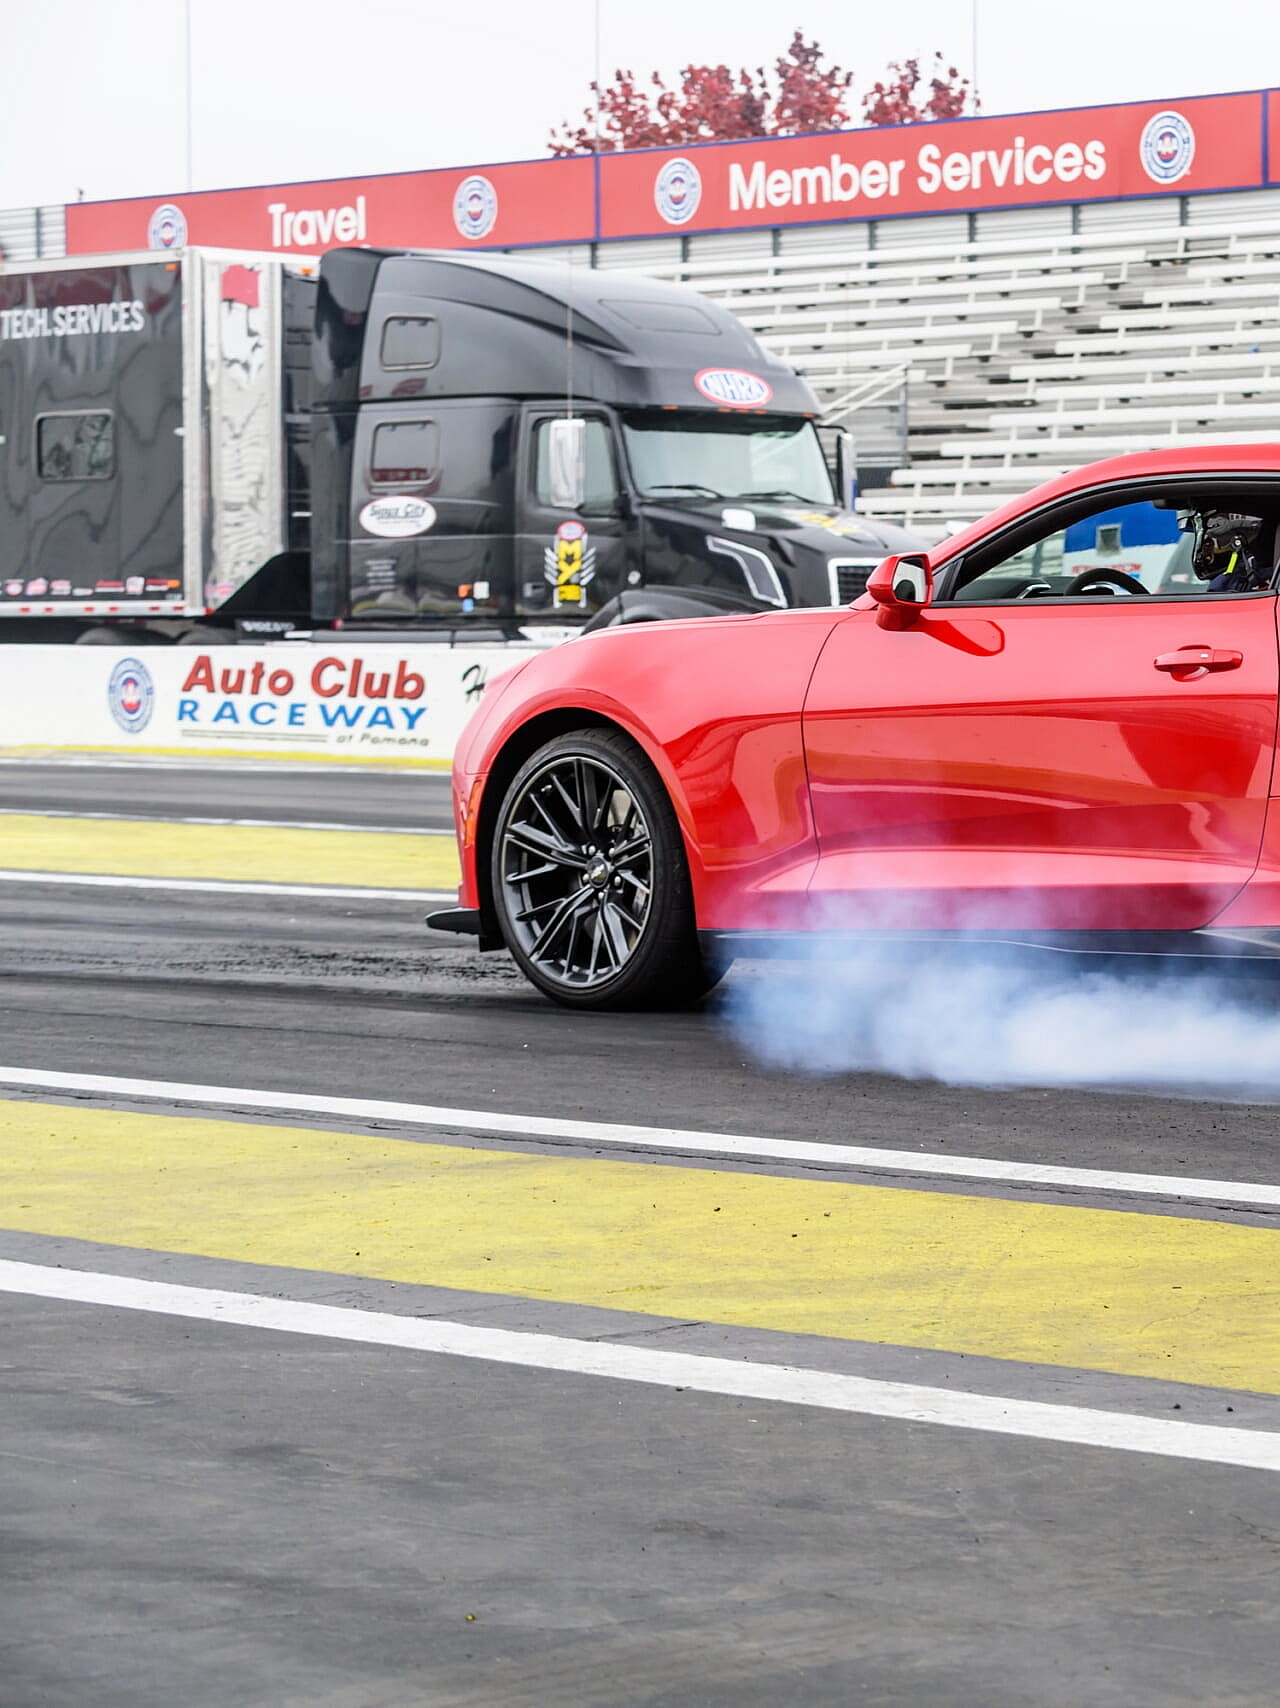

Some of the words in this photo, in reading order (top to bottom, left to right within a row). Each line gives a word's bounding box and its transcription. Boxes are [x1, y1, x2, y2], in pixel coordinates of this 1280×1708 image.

[728, 153, 906, 211] Member
[917, 136, 1107, 194] Services
[267, 195, 367, 248] Travel
[181, 655, 294, 697] Auto
[310, 656, 426, 700] Club
[177, 699, 428, 731] RACEWAY
